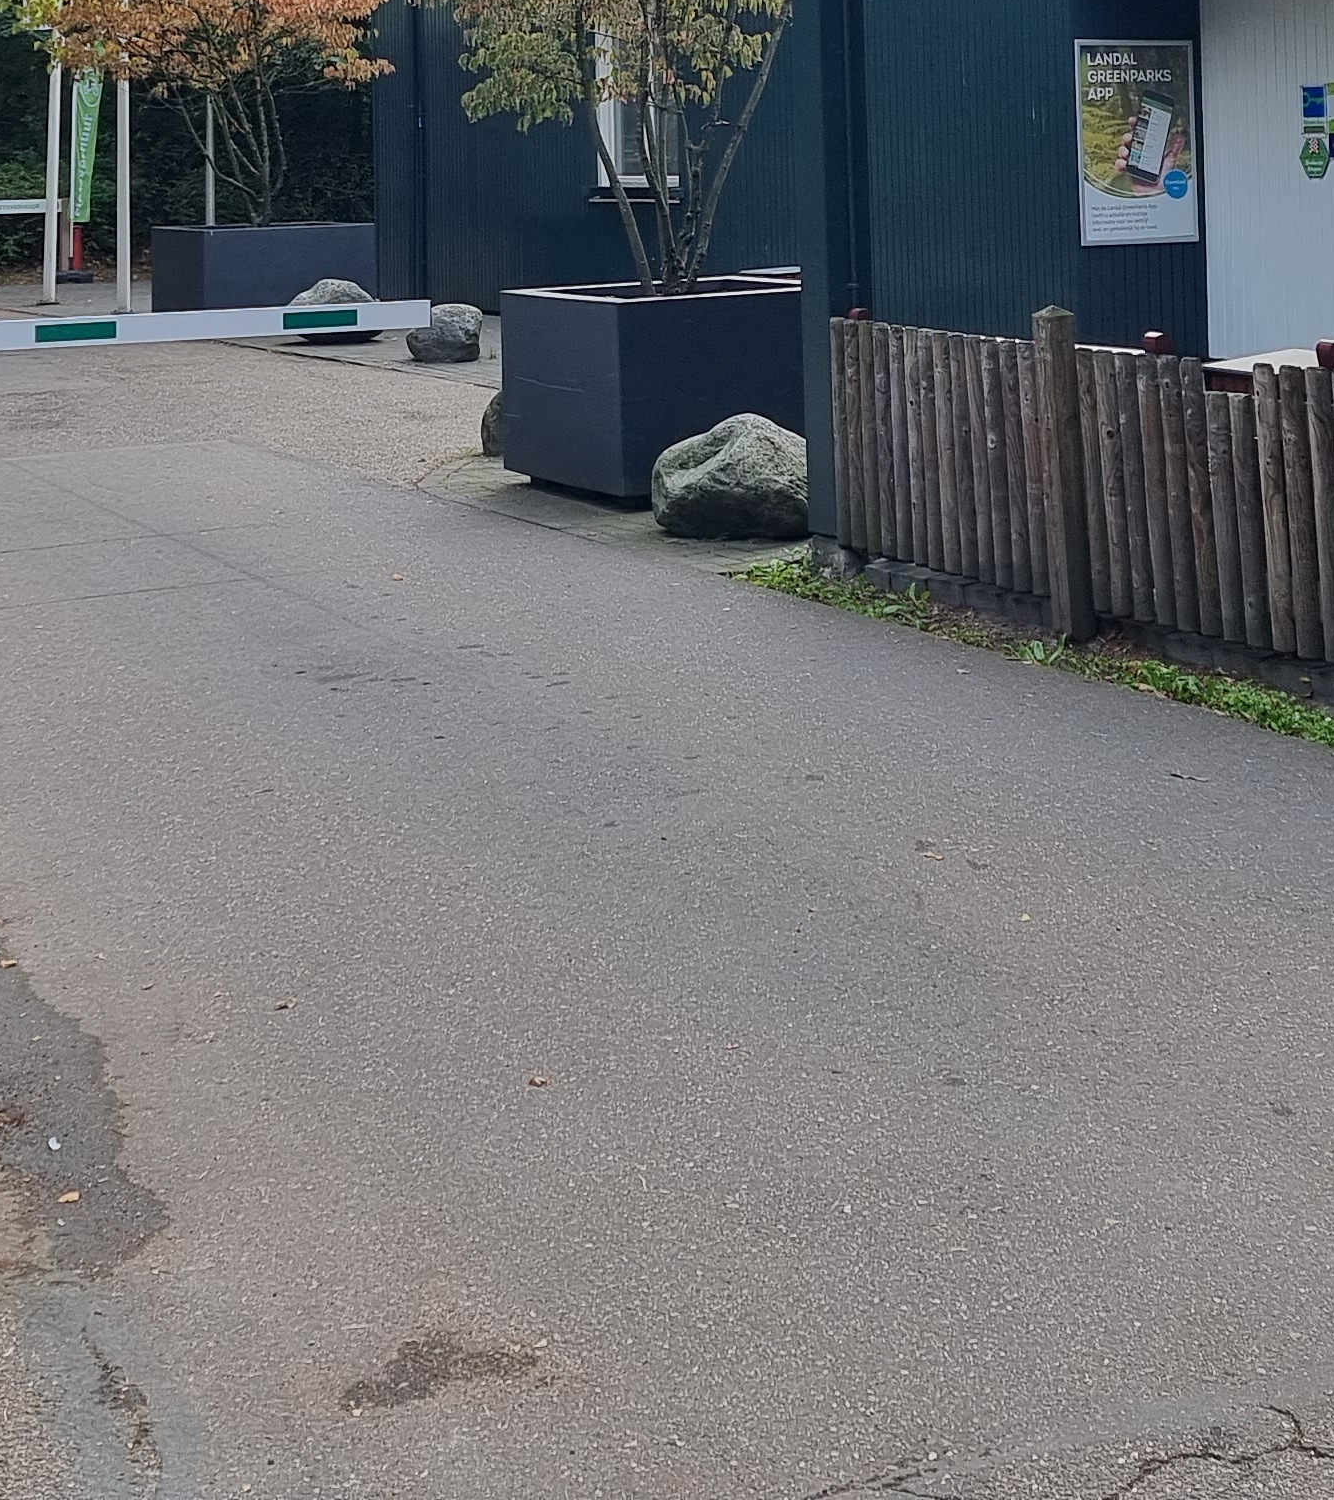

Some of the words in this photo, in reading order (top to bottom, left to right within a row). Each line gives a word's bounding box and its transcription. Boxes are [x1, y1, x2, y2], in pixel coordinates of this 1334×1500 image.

[1086, 52, 1138, 66] LANDAL
[1087, 69, 1172, 83] GREENPARKS
[1087, 87, 1114, 101] APP
